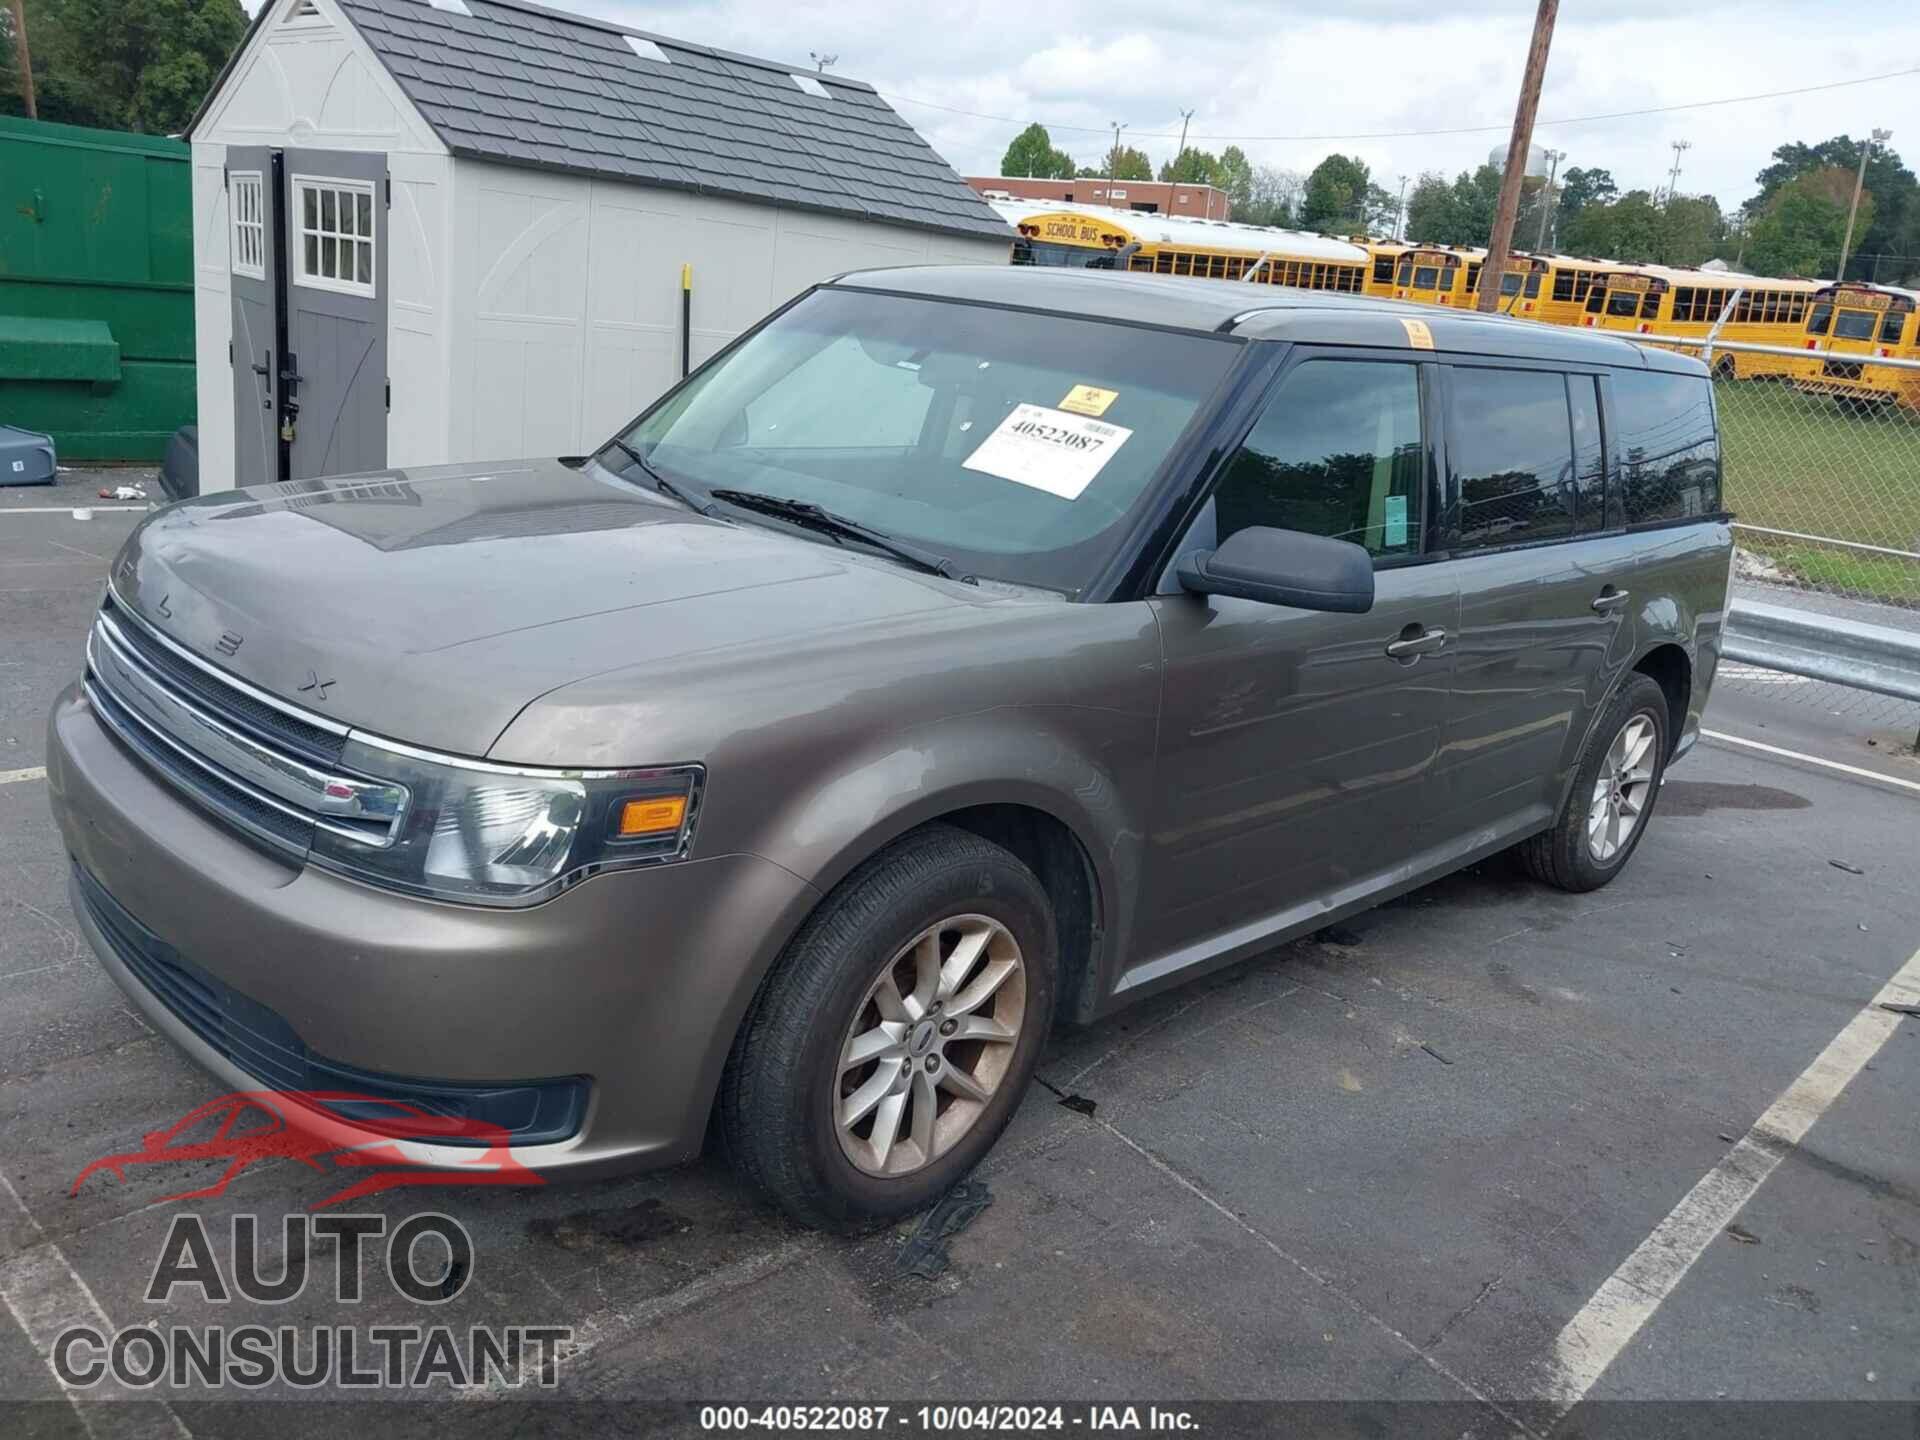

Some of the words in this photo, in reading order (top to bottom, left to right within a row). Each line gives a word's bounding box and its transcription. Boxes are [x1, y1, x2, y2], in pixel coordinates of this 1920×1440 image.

[1046, 222, 1077, 239] SCHOOL
[1080, 226, 1098, 241] BUS
[1011, 420, 1104, 453] 40522087
